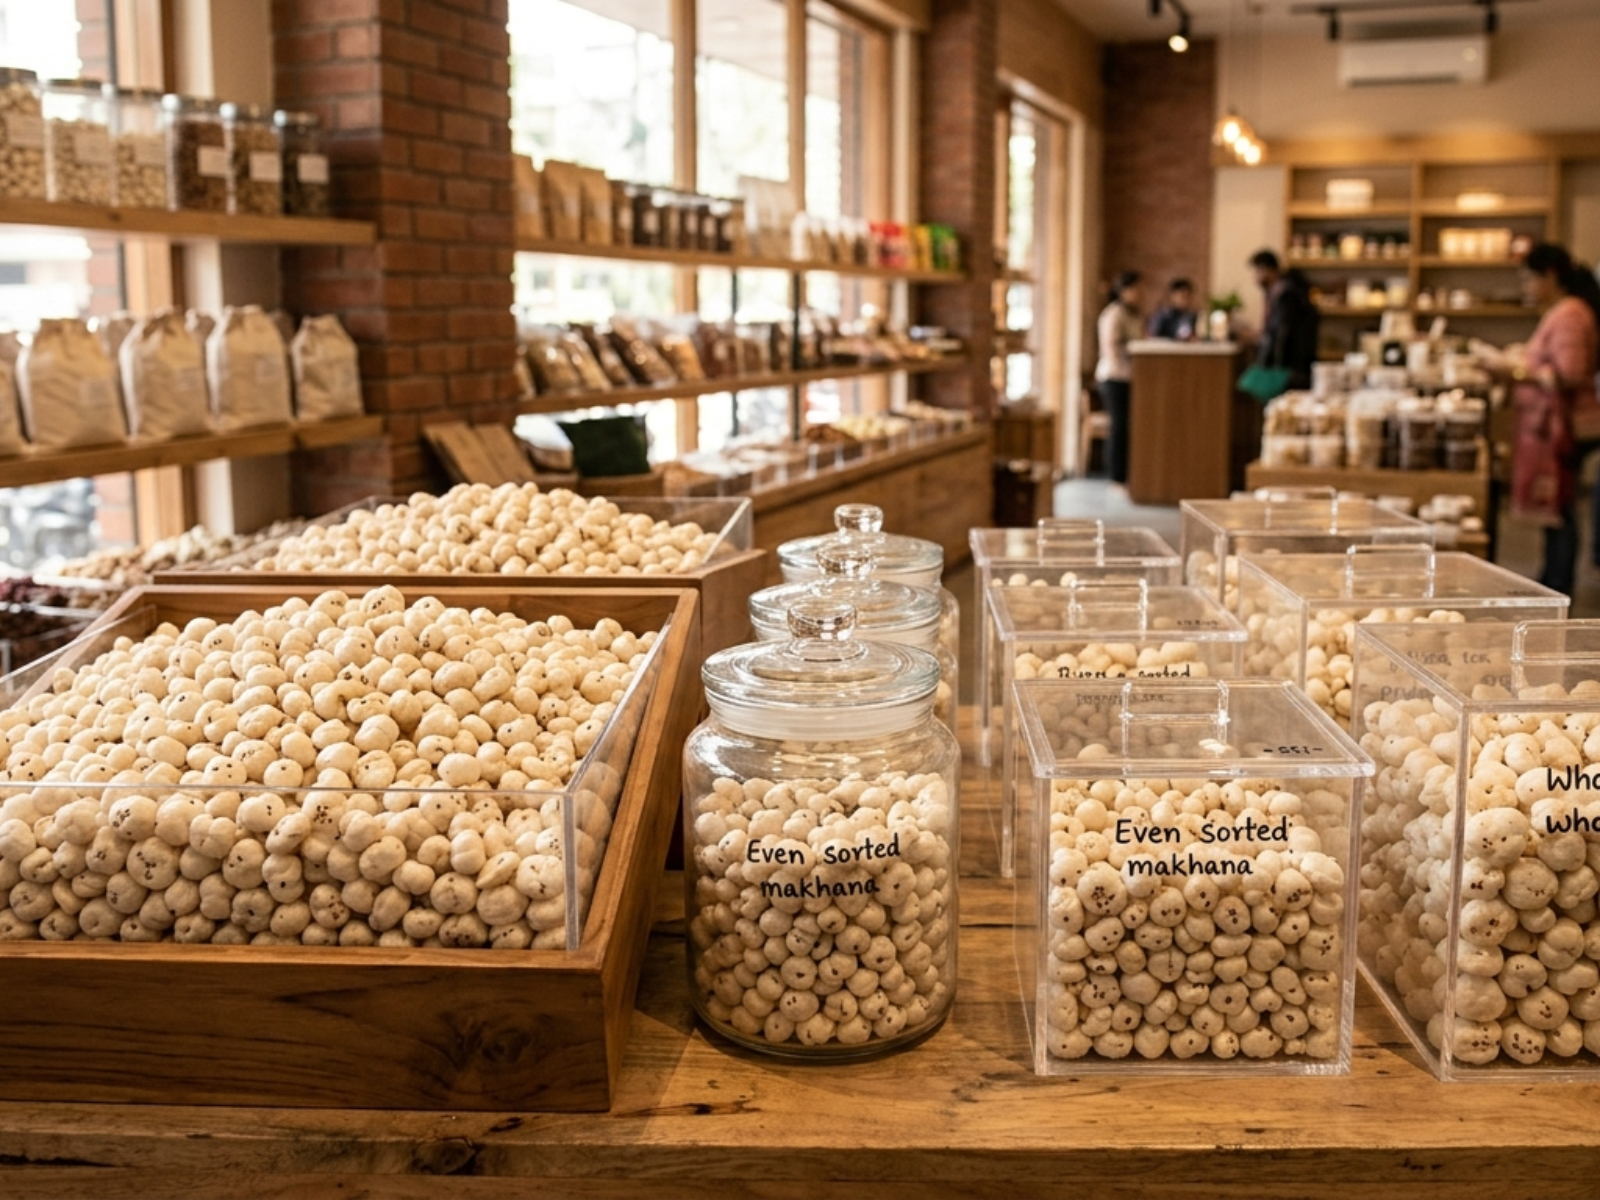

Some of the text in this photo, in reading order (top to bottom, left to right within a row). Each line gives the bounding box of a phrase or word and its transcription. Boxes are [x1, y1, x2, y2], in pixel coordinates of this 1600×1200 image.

[1115, 816, 1288, 844] Even sorted
[746, 833, 900, 864] Even sorted
[1127, 853, 1253, 877] makhana
[760, 876, 880, 898] makhana
